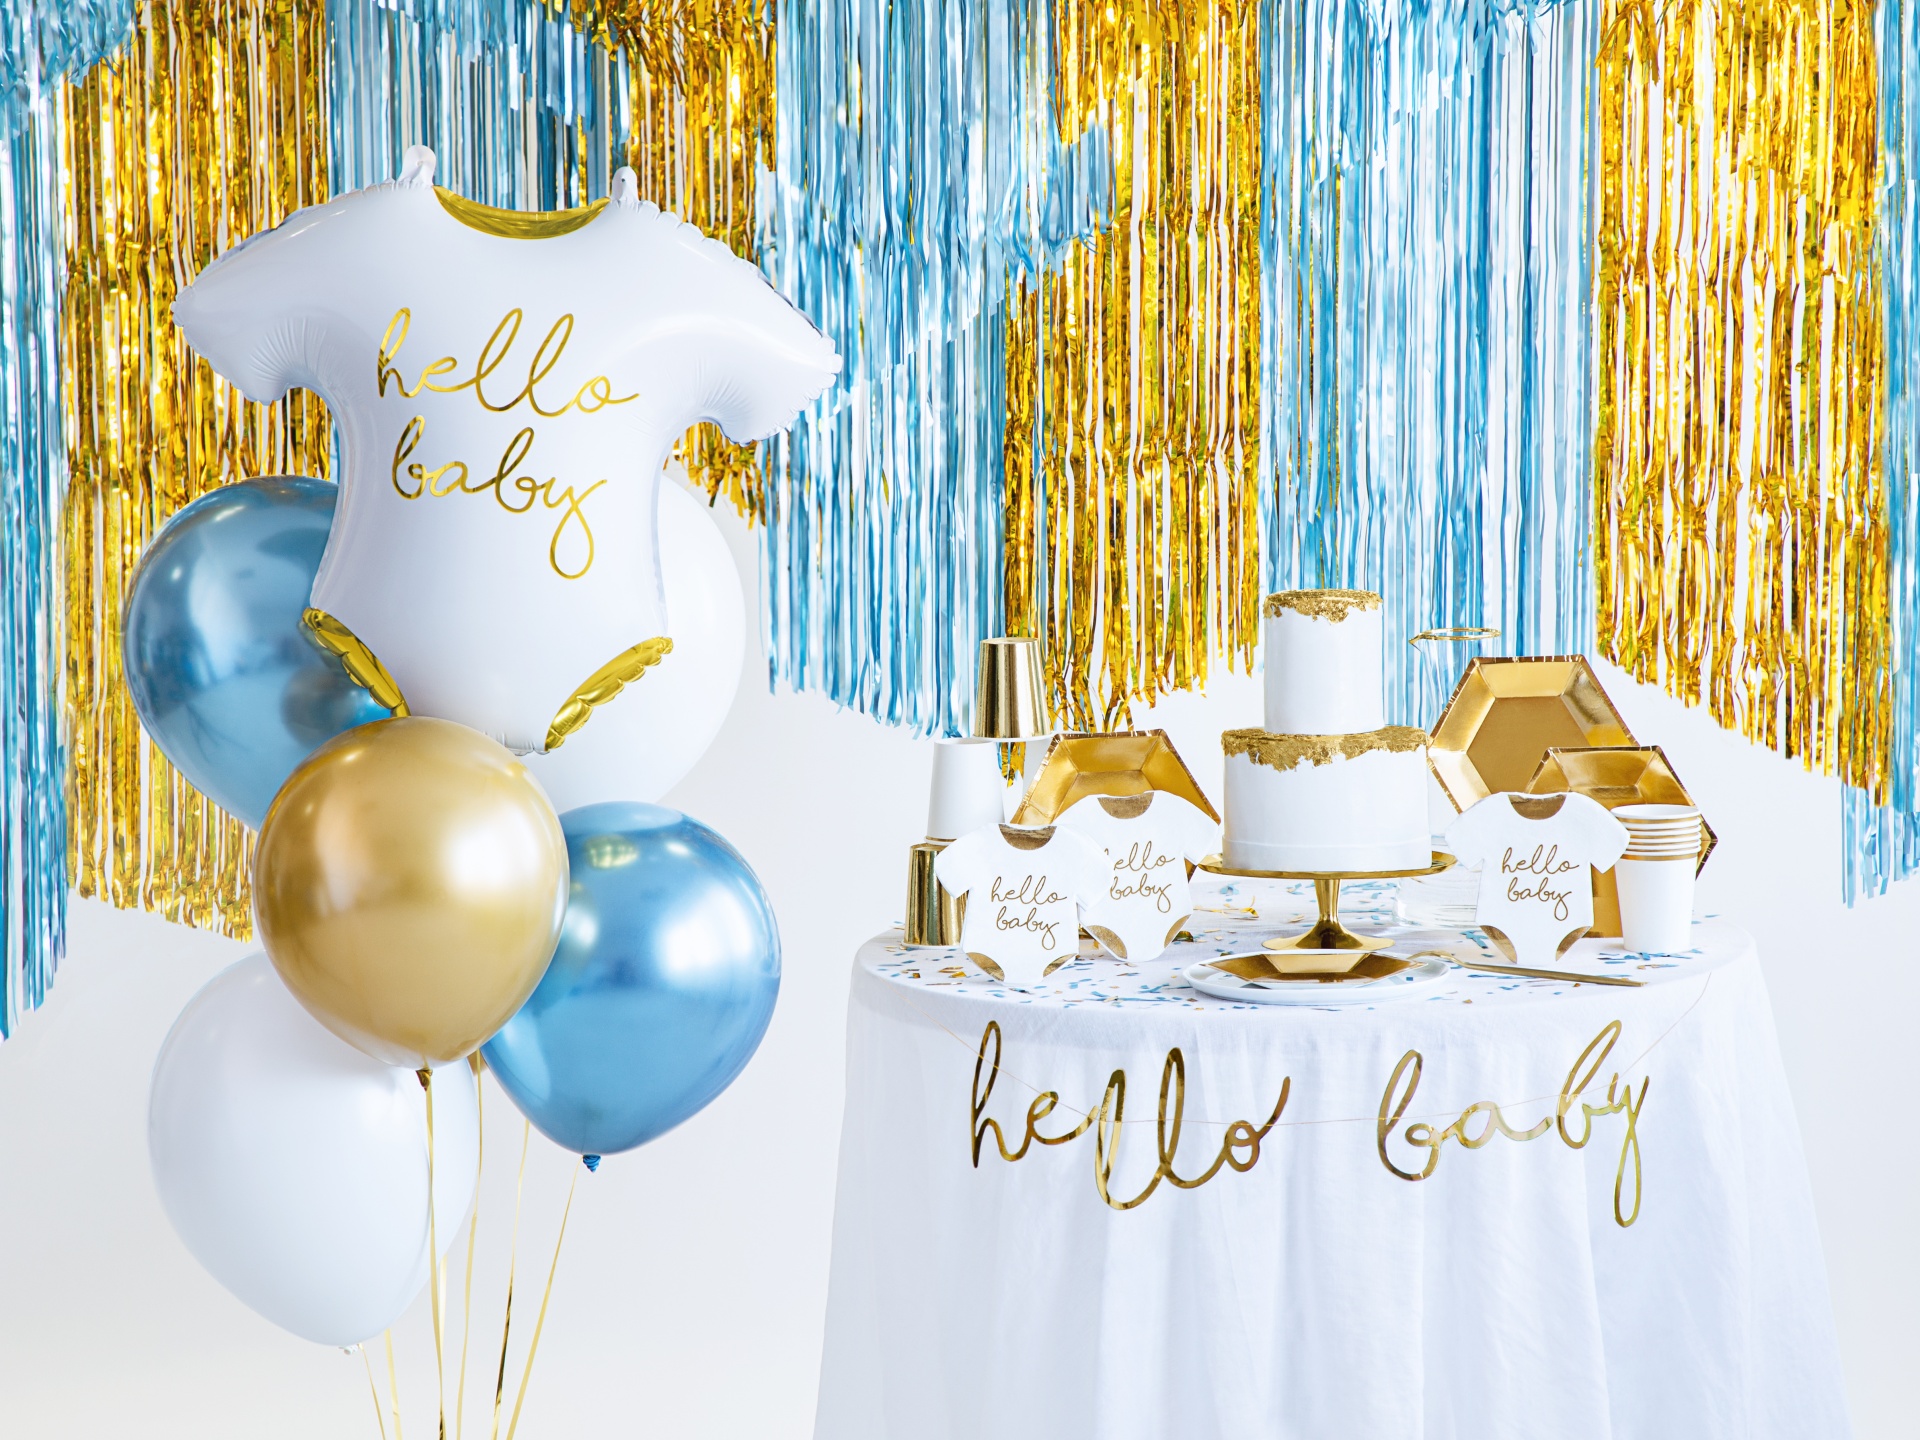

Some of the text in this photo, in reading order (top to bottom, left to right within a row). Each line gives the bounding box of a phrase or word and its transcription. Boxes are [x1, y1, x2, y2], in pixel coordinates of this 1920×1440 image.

[377, 306, 640, 417] hello
[391, 414, 607, 579] baby
[1104, 840, 1175, 871] ello
[1502, 844, 1579, 875] hello
[991, 874, 1067, 905] hello
[1110, 873, 1171, 913] baby
[1507, 877, 1572, 921] baby
[996, 905, 1060, 950] baby
[972, 1019, 1650, 1228] hello baby
